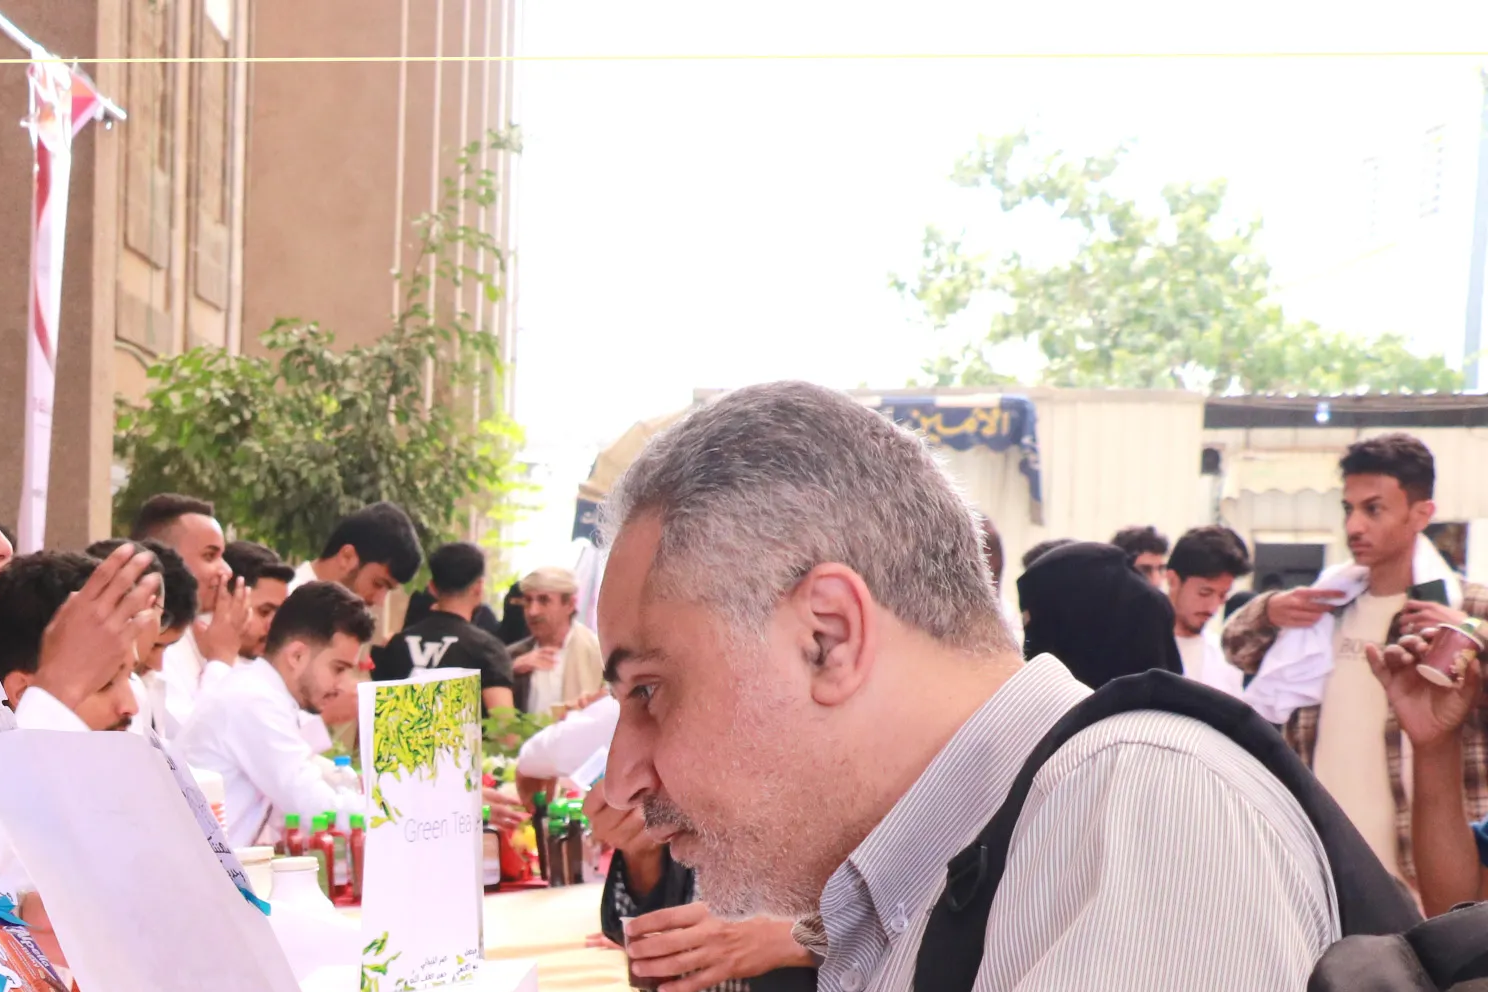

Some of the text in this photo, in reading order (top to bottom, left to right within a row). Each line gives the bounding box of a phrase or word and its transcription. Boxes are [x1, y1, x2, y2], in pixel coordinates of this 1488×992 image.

[404, 635, 459, 669] W
[403, 817, 448, 844] Green
[451, 810, 473, 835] Tea
